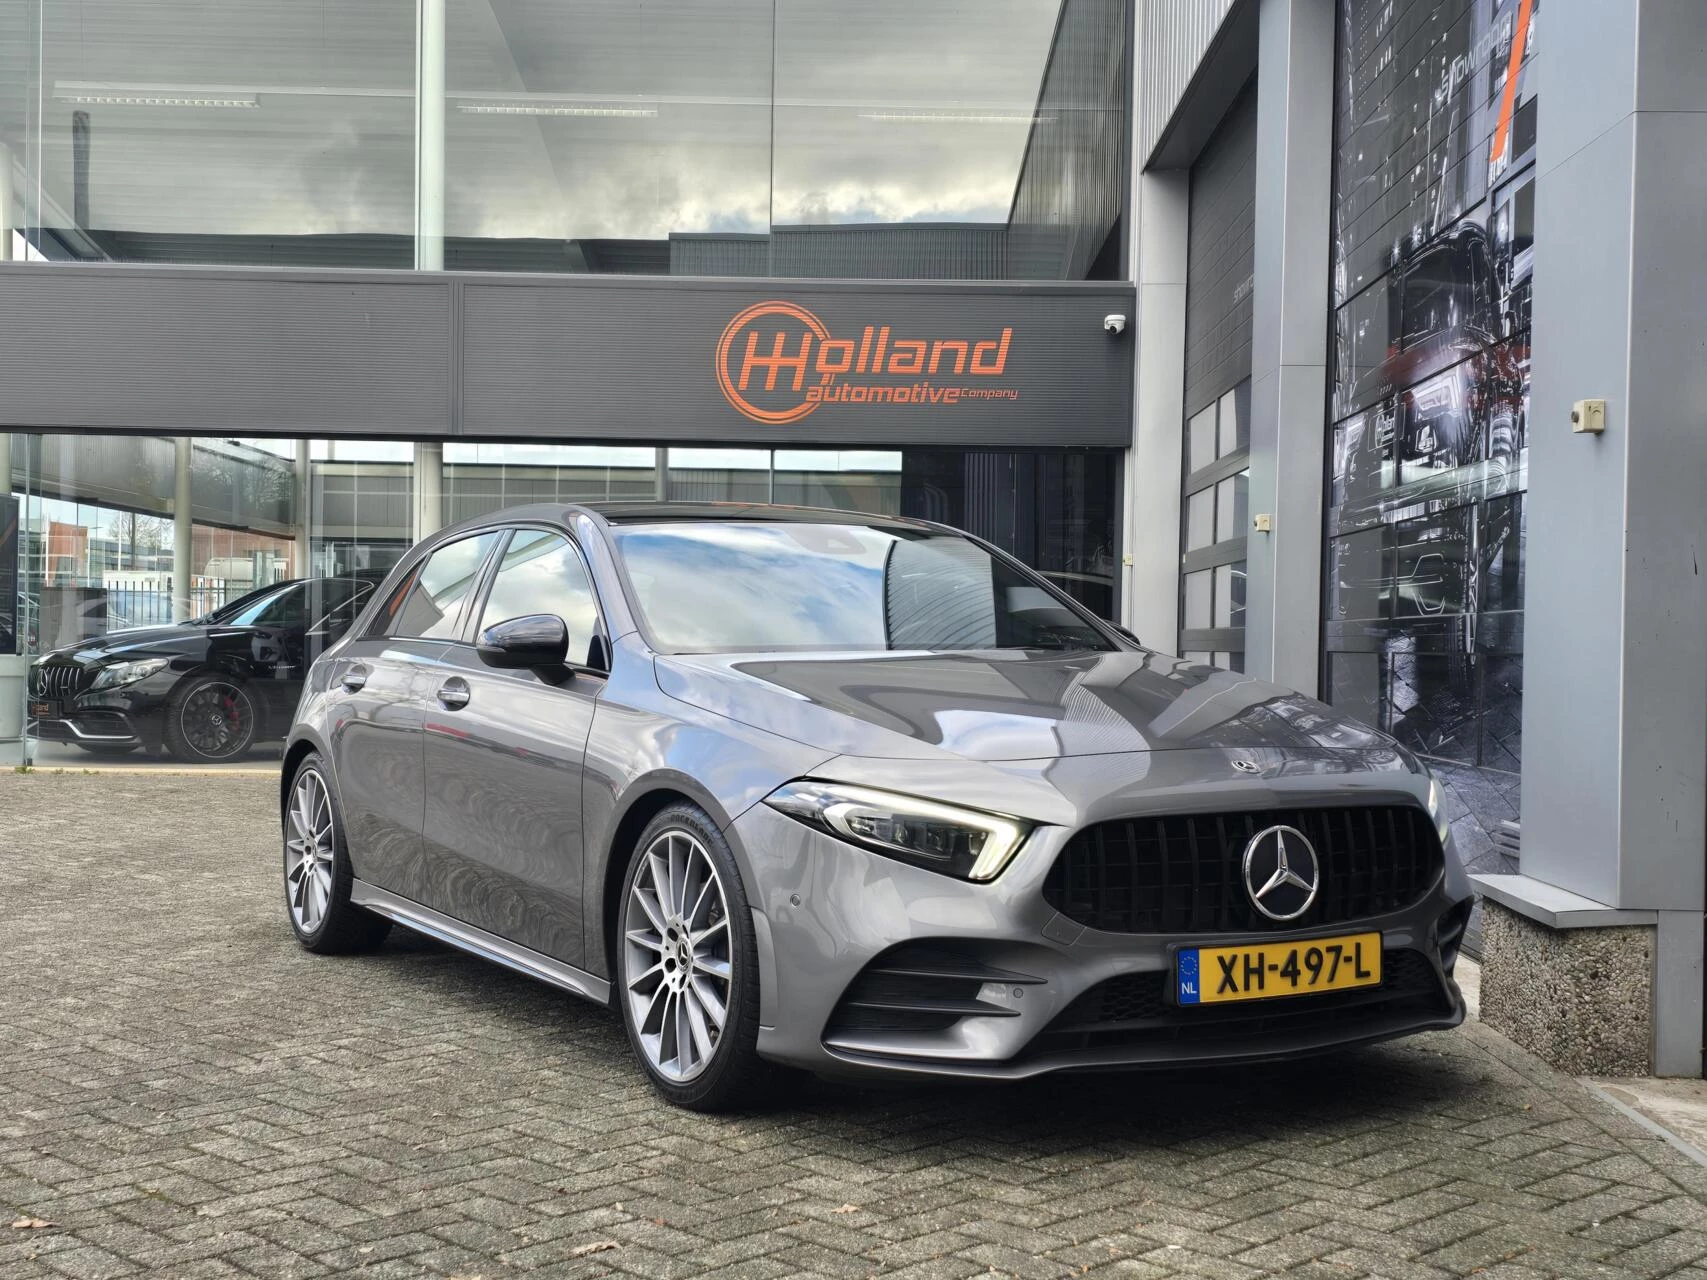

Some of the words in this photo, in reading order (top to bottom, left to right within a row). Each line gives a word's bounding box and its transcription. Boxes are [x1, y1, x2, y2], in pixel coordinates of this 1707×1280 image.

[738, 326, 1012, 391] Holland
[805, 381, 960, 405] automotive
[1216, 942, 1371, 994] XH-497-L
[1181, 981, 1198, 995] NL
